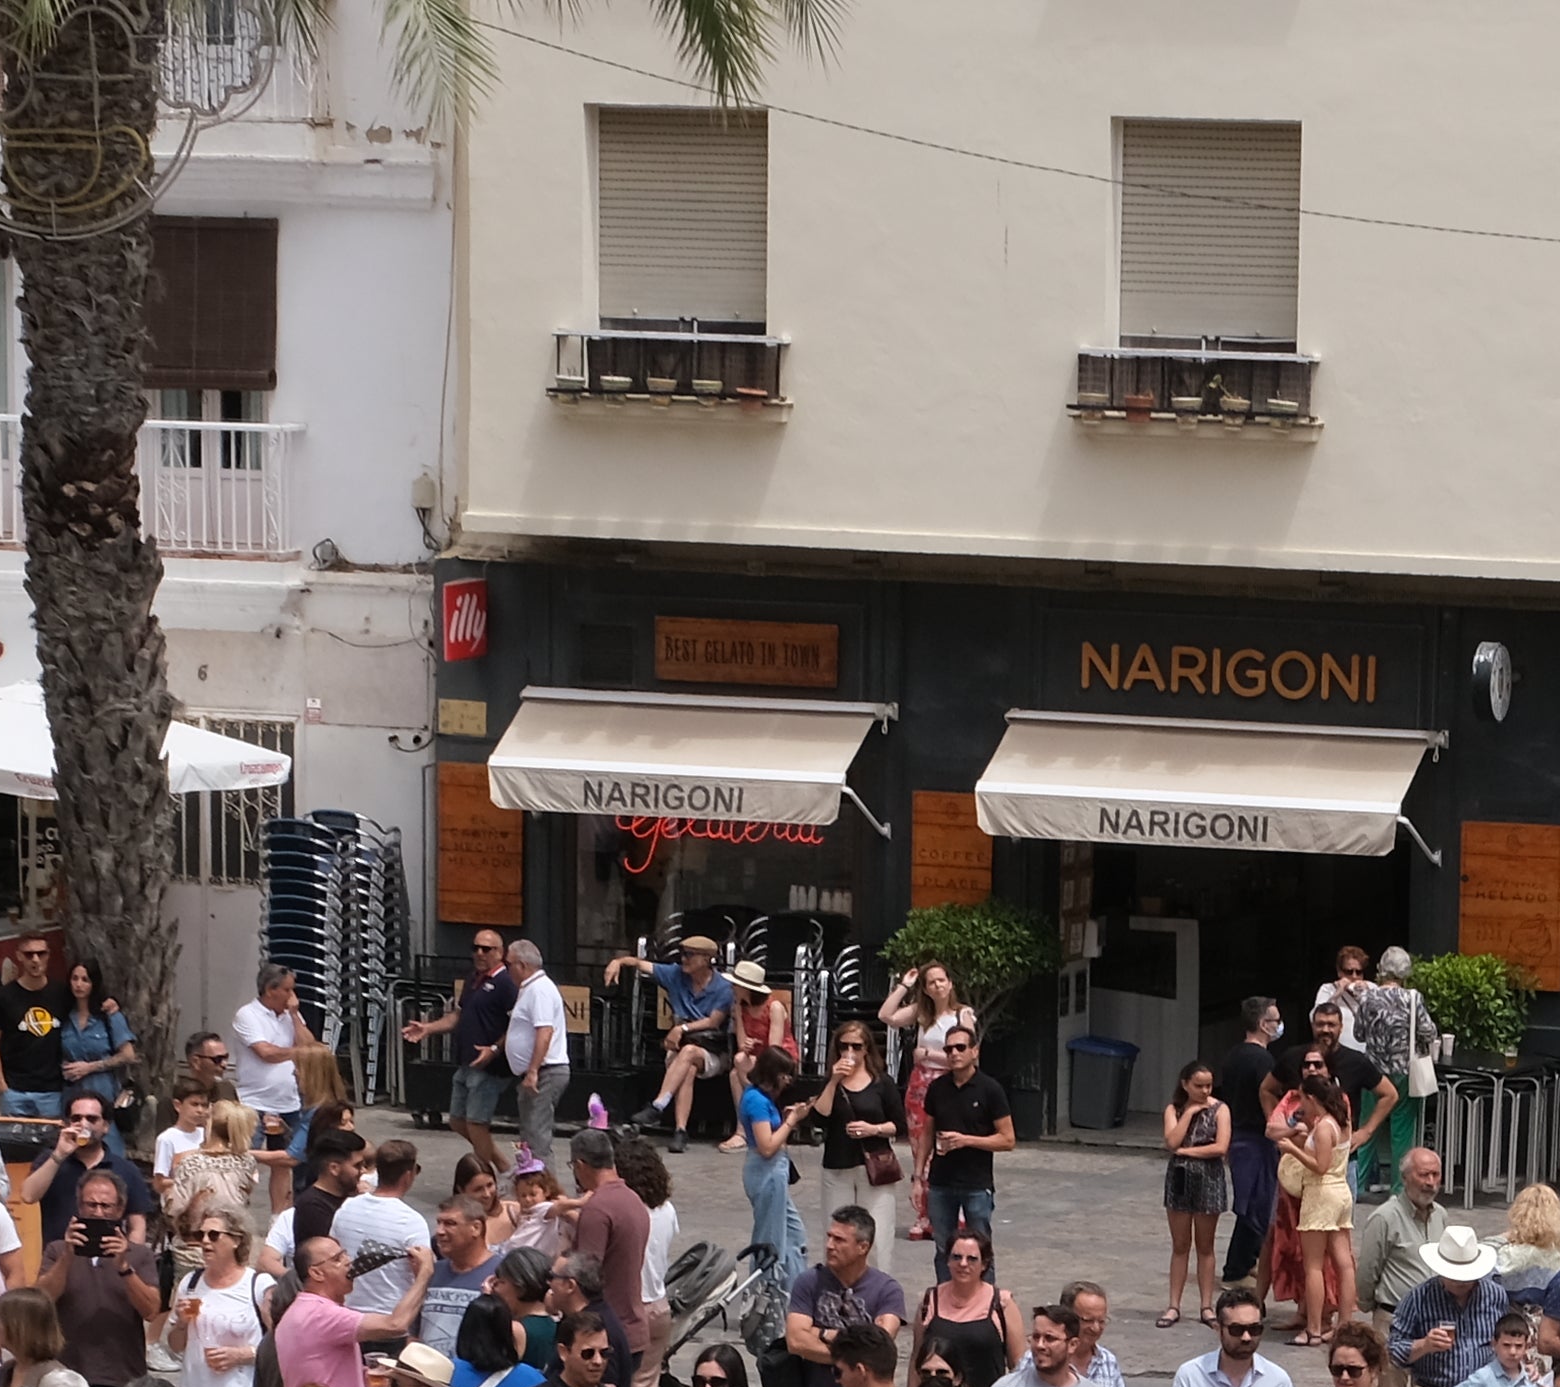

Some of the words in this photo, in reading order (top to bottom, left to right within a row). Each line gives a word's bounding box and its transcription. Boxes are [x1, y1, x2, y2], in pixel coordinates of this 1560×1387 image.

[450, 593, 487, 652] illy
[665, 636, 696, 662] BEST
[704, 639, 754, 665] GELATO
[761, 641, 777, 667] IN
[783, 643, 820, 670] TOWN
[198, 664, 208, 682] 6
[1081, 641, 1376, 703] NARIGONI
[583, 779, 744, 815] NARIGONI
[1099, 807, 1269, 843] NARIGONI
[919, 847, 986, 861] COFFEE
[923, 877, 980, 890] PLACE
